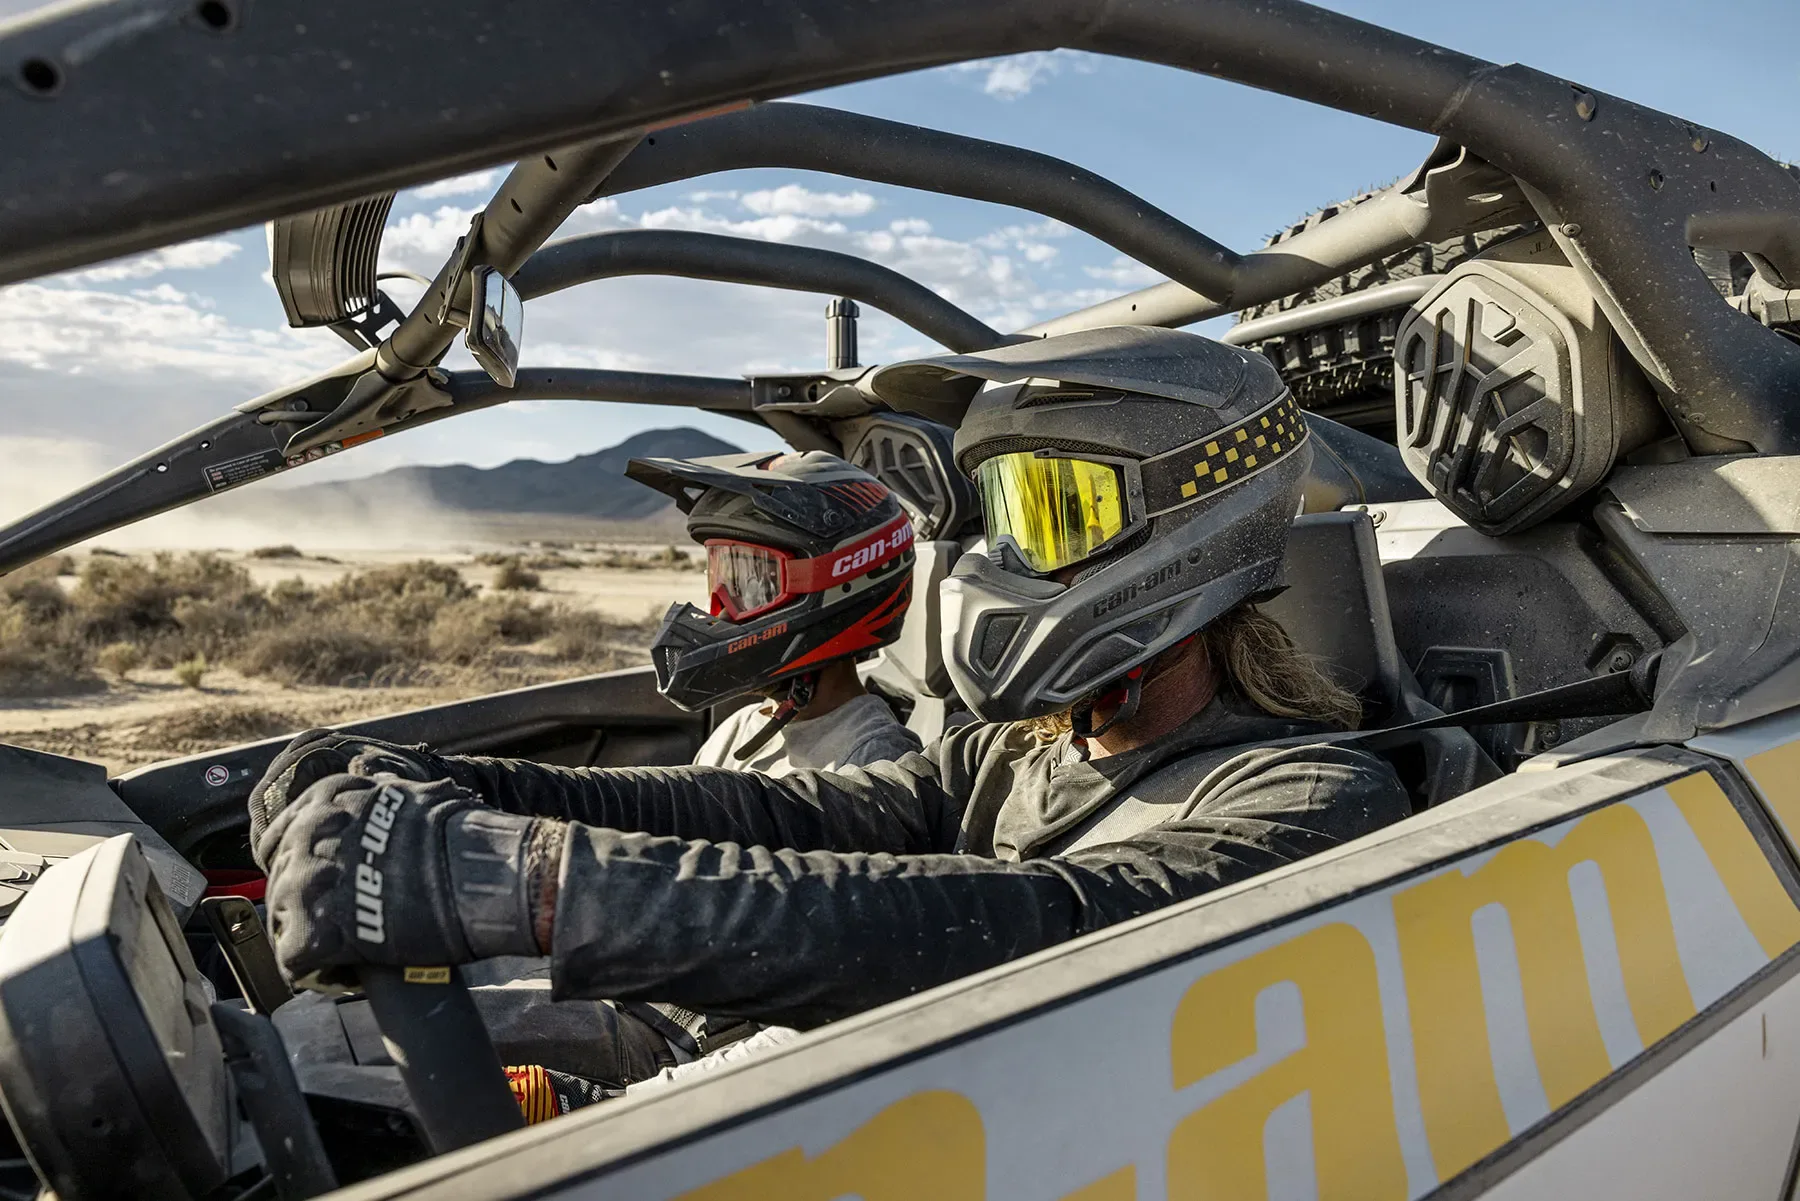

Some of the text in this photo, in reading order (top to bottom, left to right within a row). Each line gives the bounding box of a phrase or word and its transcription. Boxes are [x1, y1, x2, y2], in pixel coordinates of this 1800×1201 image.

[832, 521, 913, 578] can-am
[1093, 559, 1182, 619] can-am
[727, 622, 788, 655] can-am
[355, 786, 405, 944] can-am
